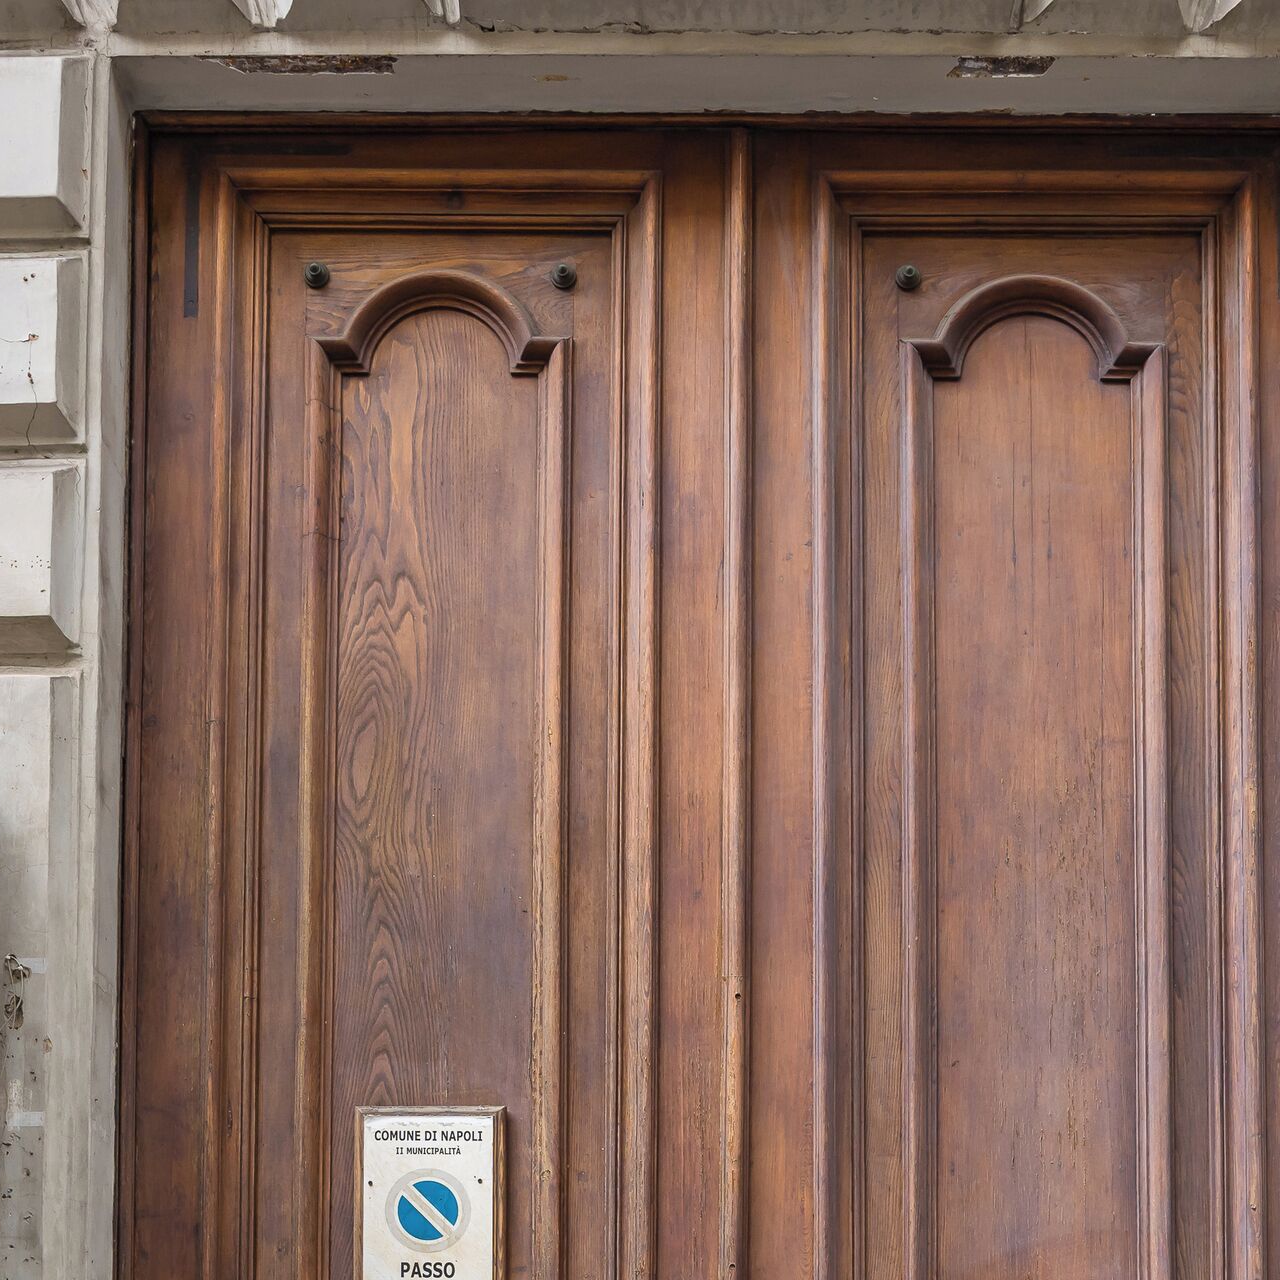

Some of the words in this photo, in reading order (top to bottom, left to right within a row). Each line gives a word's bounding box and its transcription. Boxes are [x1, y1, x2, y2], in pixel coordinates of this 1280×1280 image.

[374, 1130, 421, 1142] COMUNE
[424, 1130, 438, 1142] DI
[440, 1130, 484, 1142] NAPOLI
[406, 1145, 462, 1156] MUNICIPALITÀ
[400, 1262, 456, 1279] PASSO
